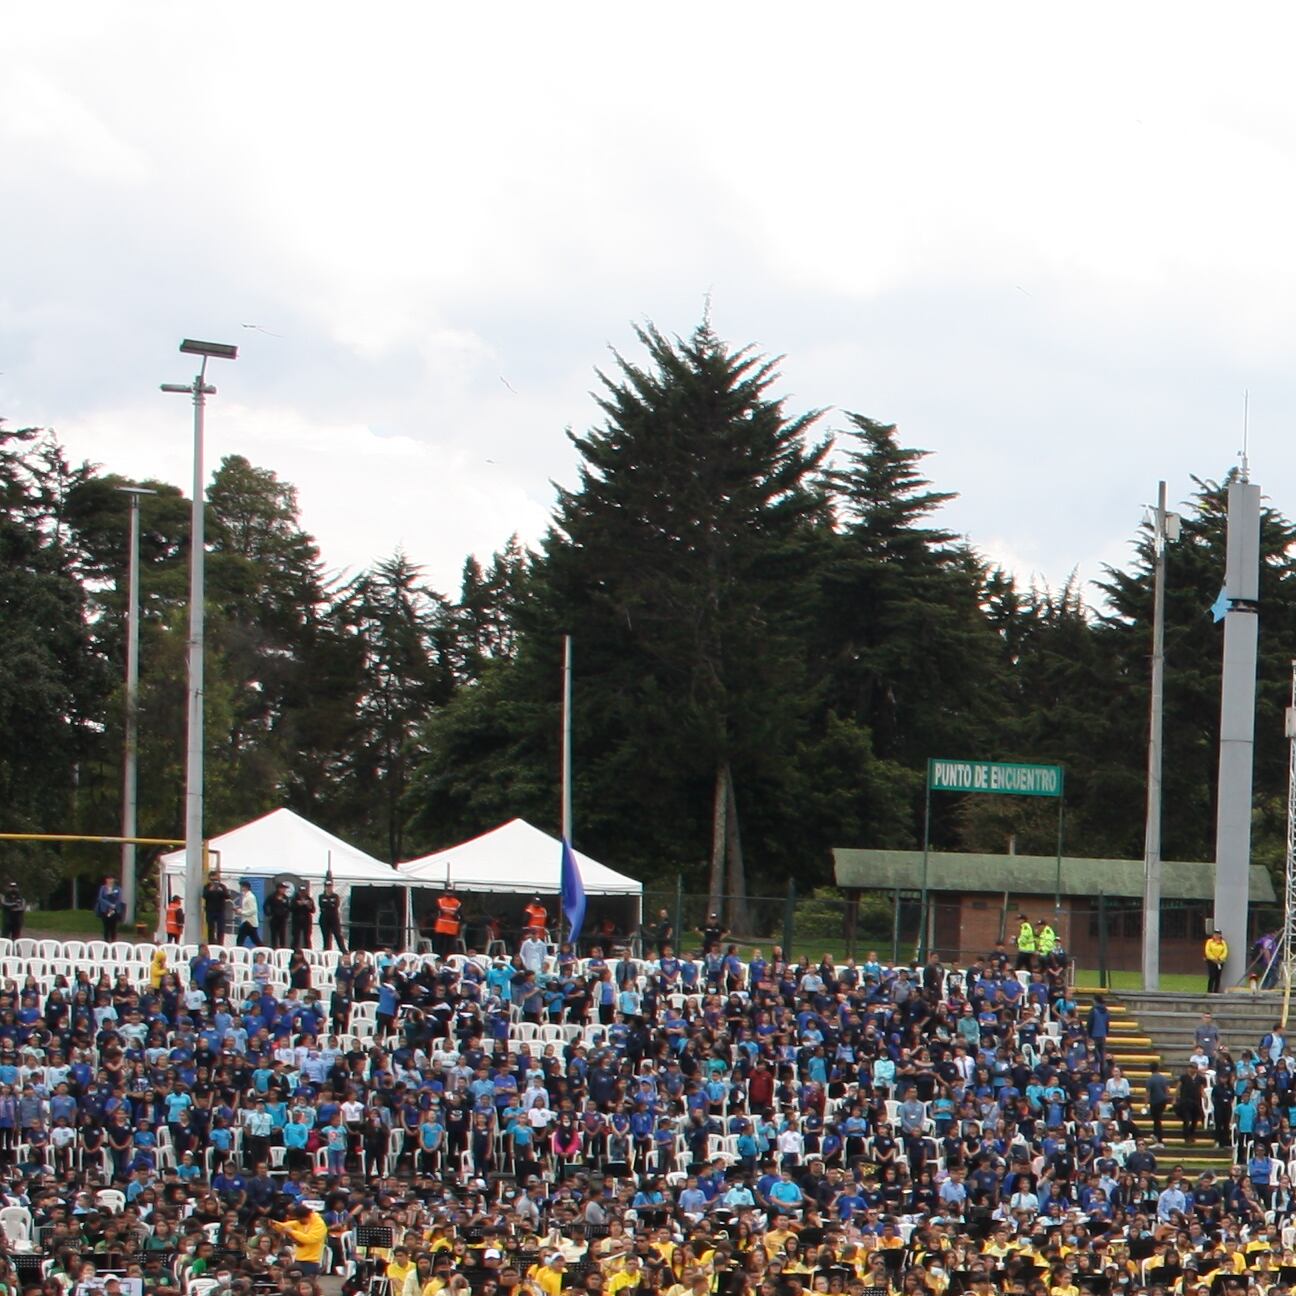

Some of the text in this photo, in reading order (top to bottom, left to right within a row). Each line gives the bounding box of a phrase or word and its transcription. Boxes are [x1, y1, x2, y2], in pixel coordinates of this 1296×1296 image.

[934, 763, 1057, 792] PUNTO DE ENCUENTRO
